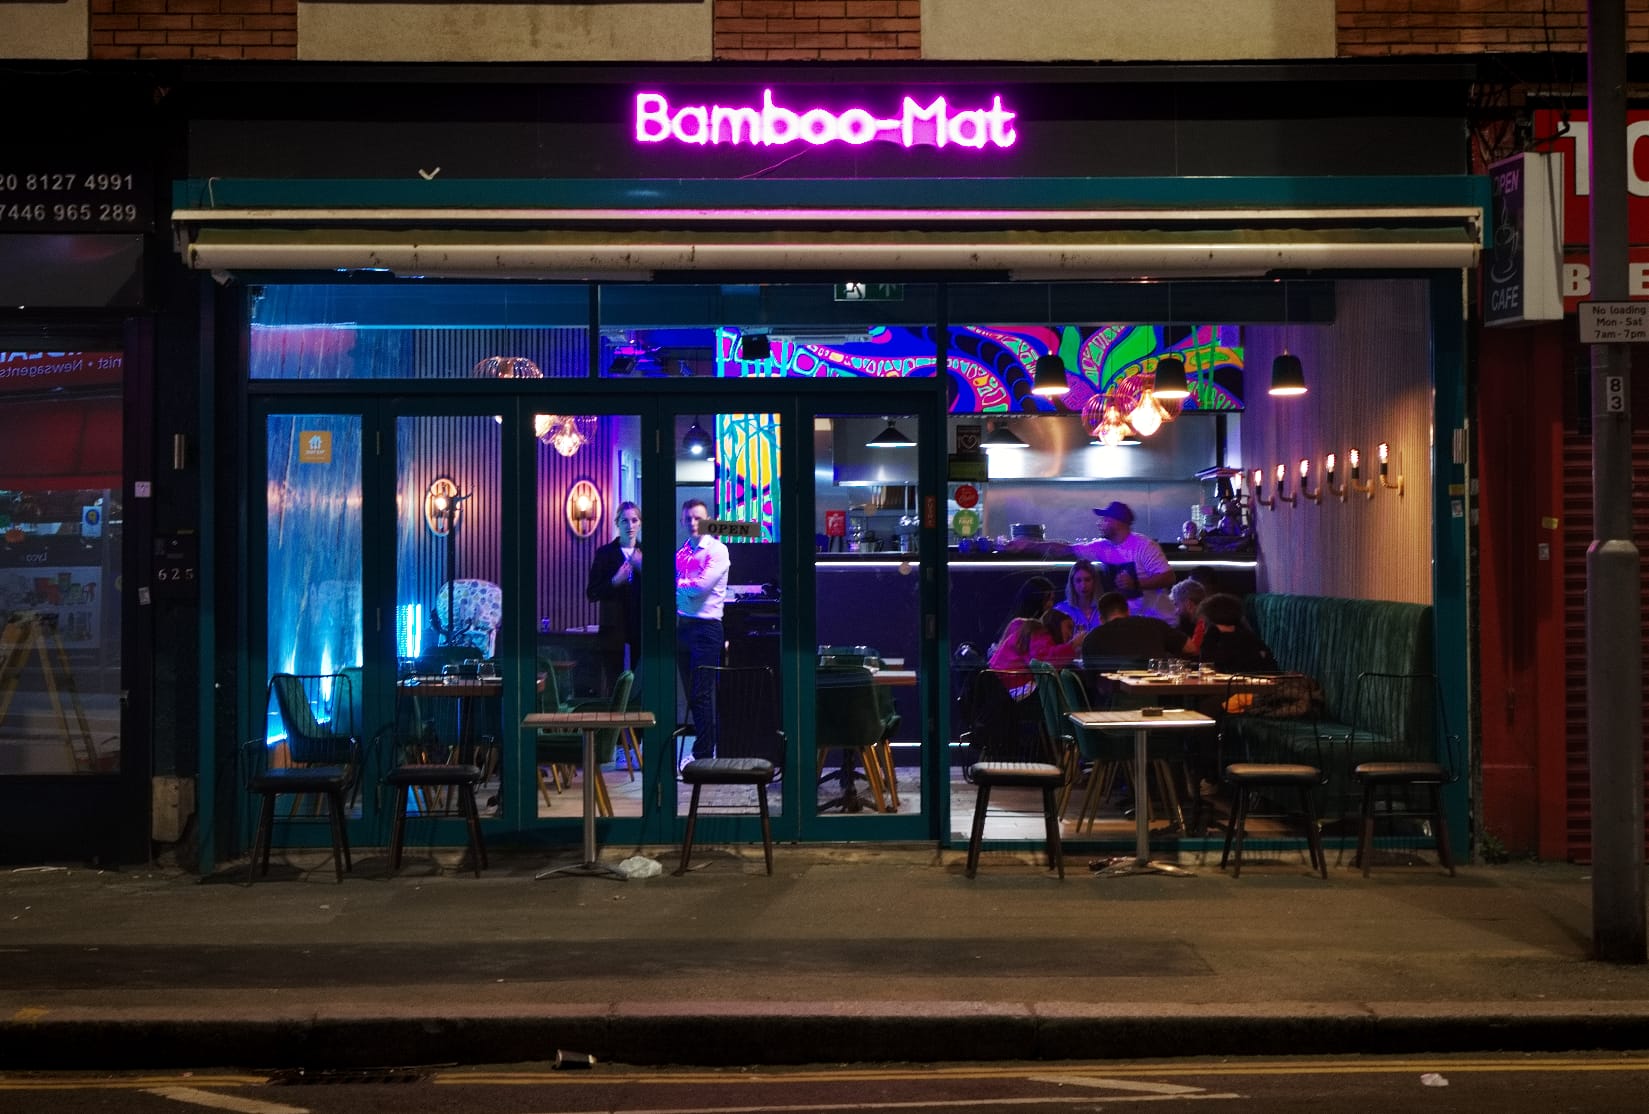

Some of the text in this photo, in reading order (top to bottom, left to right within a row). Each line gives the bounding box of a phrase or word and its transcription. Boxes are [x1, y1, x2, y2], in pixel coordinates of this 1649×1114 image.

[635, 88, 1017, 148] Bamboo-Mat
[26, 173, 77, 191] 8127
[84, 173, 133, 191] 4991
[53, 203, 92, 221] 965
[99, 203, 137, 221] 289
[1592, 305, 1647, 316] No loading
[1596, 318, 1617, 327] Mon
[1625, 317, 1643, 326] Sat
[1594, 330, 1616, 339] 7am
[1624, 329, 1647, 339] 7pm
[708, 523, 750, 535] OPEN
[158, 568, 195, 580] 625
